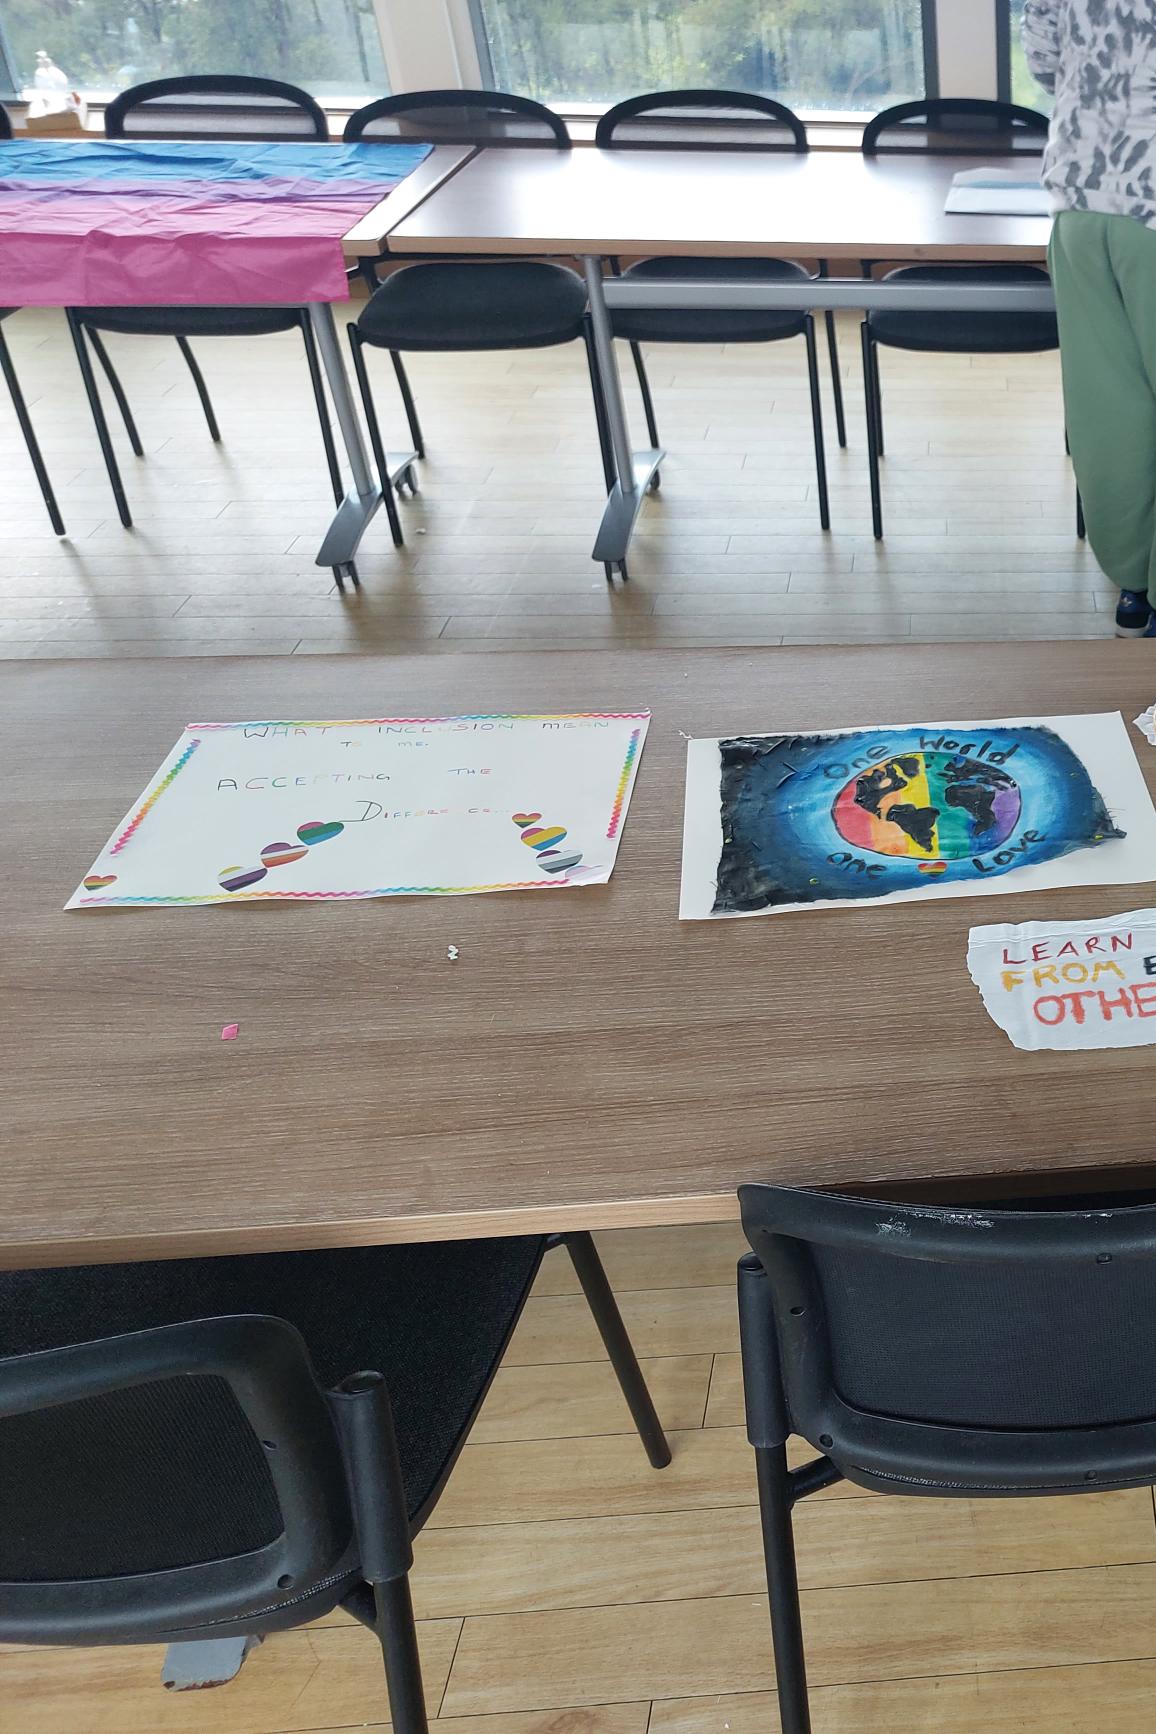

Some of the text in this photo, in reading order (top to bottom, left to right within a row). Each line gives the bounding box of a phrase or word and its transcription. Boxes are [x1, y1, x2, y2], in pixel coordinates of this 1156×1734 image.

[243, 726, 332, 738] WHAT
[447, 767, 493, 776] THE
[823, 734, 1021, 781] One World
[825, 850, 892, 880] One
[1002, 931, 1134, 966] LEARN
[1001, 959, 1127, 993] FROM
